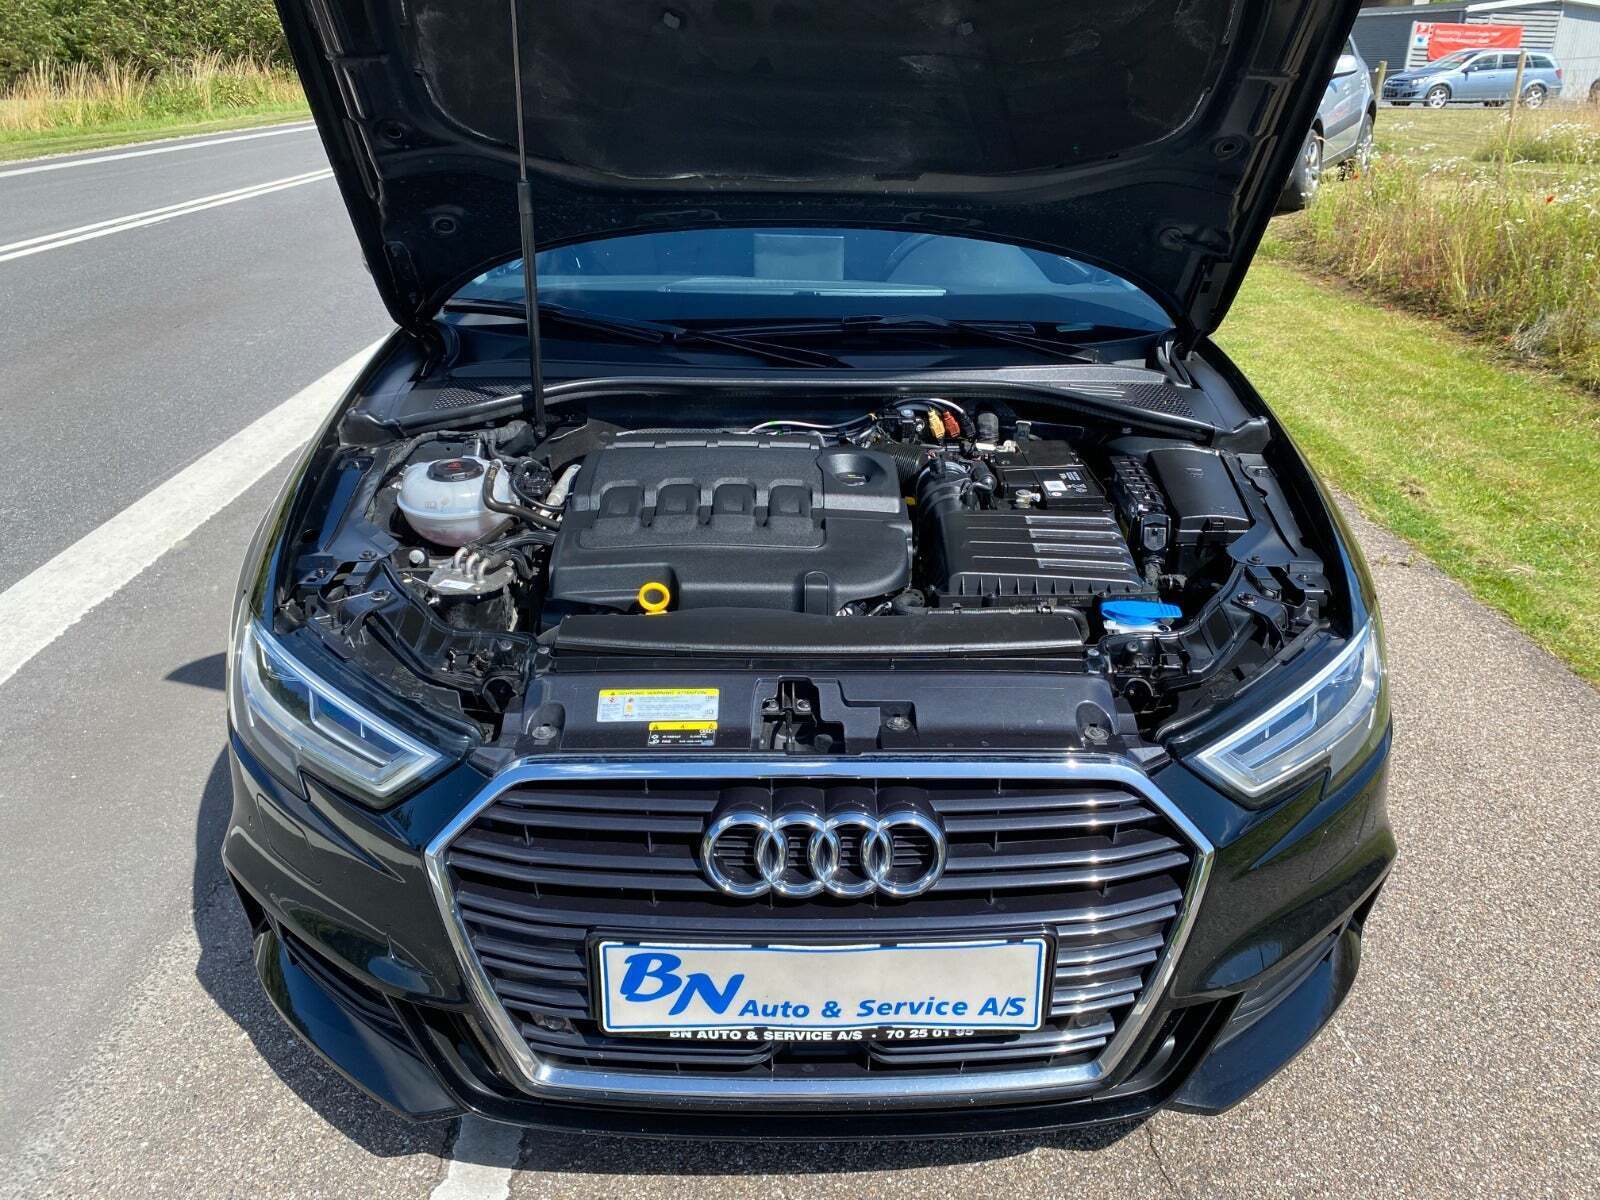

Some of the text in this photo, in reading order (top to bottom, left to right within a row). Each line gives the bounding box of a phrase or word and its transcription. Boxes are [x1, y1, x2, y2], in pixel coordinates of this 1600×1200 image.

[619, 952, 1027, 1018] BN Auto & Service A/S
[669, 1030, 692, 1038] BN
[697, 1030, 742, 1040] AUTO
[746, 1031, 759, 1040] &
[763, 1031, 833, 1041] SERVICE
[837, 1031, 863, 1041] A/S
[886, 1029, 905, 1039] 70
[909, 1029, 928, 1038] 25
[932, 1029, 950, 1037] 01
